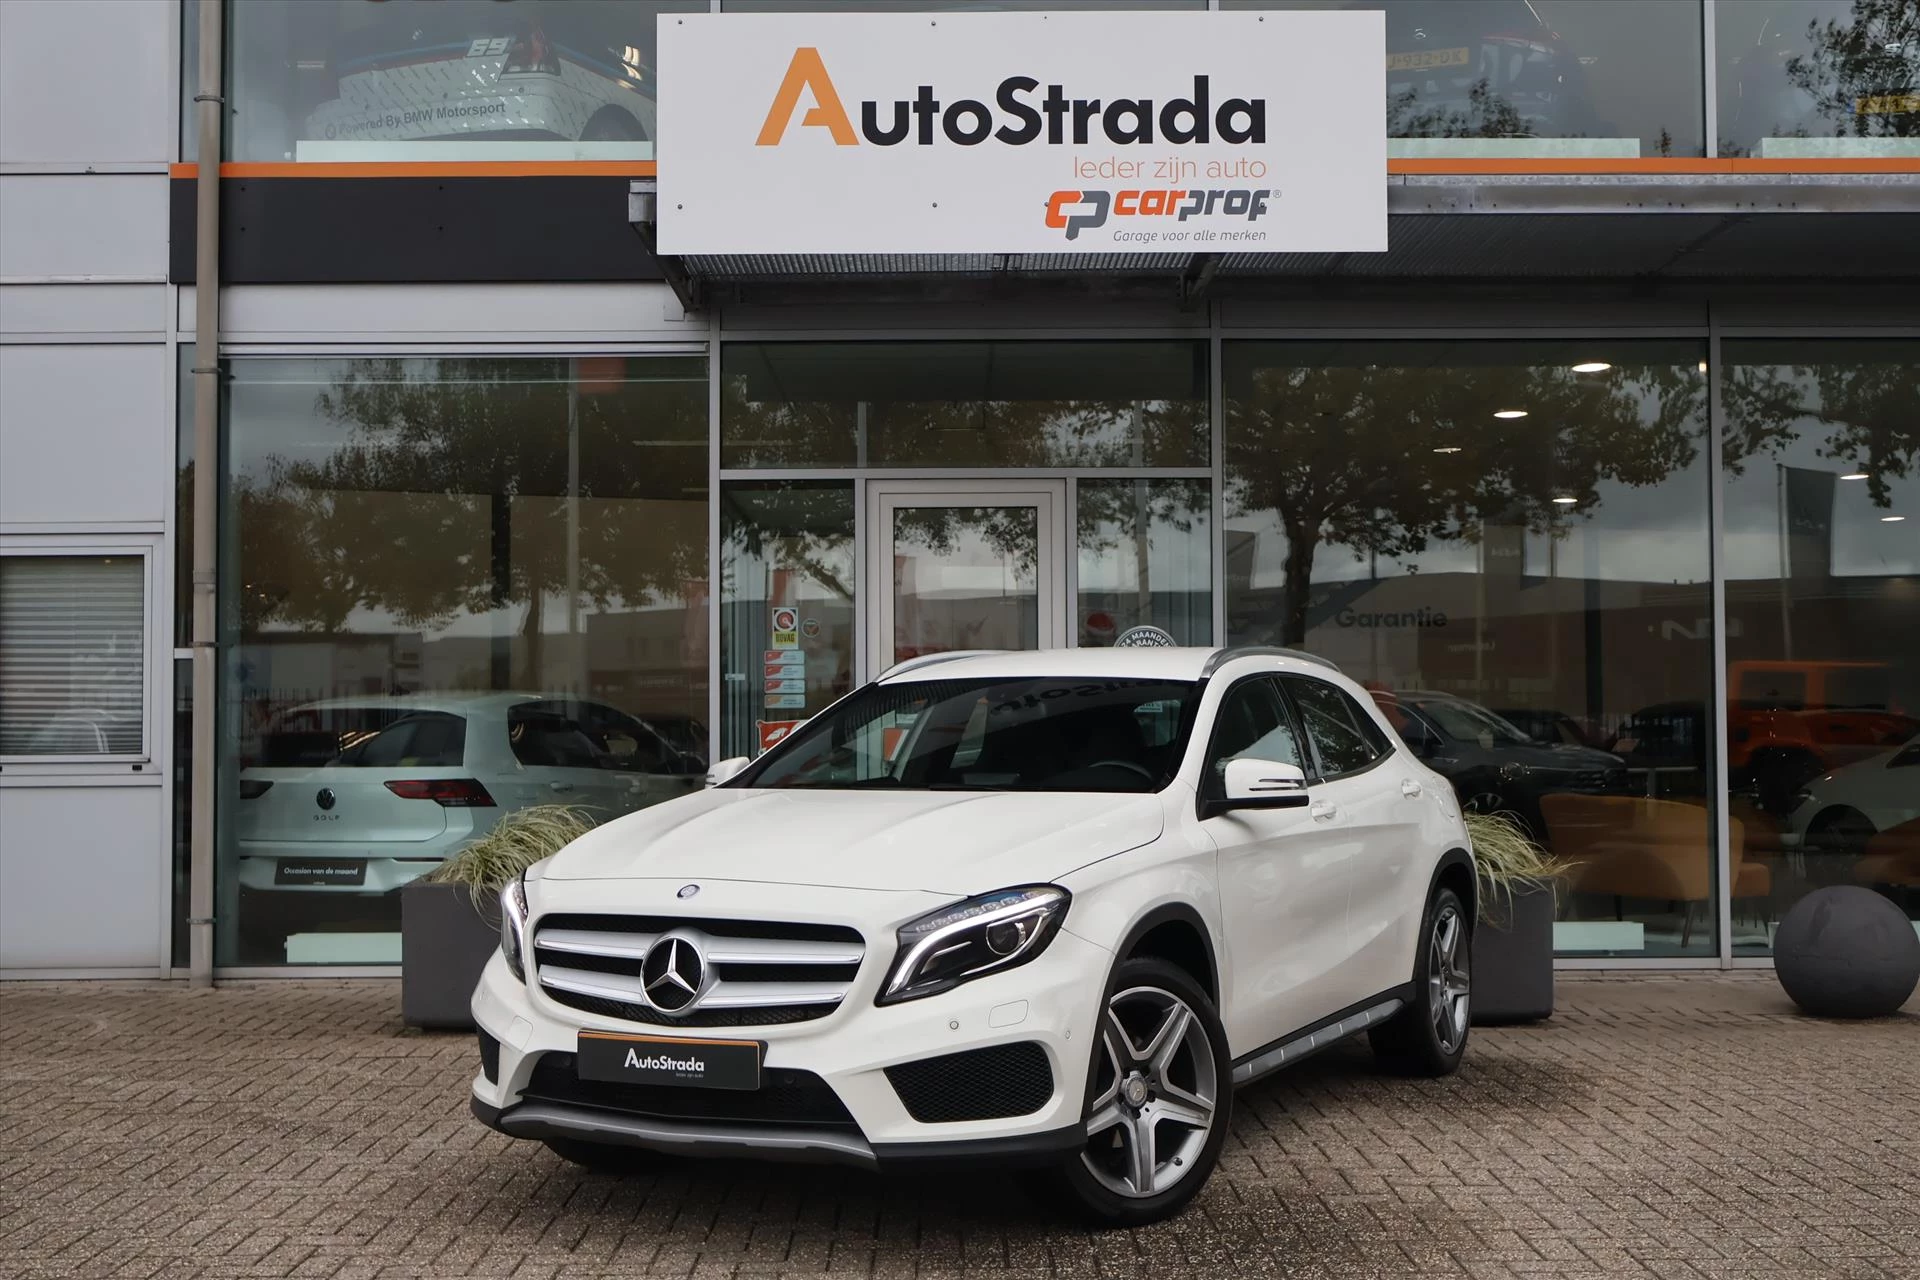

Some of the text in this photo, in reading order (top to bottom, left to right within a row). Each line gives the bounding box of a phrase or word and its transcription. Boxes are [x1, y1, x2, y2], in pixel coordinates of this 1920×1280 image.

[755, 47, 1266, 146] AutoStrada
[386, 115, 401, 129] By
[404, 108, 433, 124] BMW
[437, 103, 505, 119] Motorsport
[1074, 156, 1267, 184] Ieder zijn auto
[1113, 230, 1266, 244] Garage voor alle merken
[1335, 606, 1448, 627] Garantie
[284, 866, 311, 875] Occasion
[326, 867, 333, 875] de
[335, 867, 358, 876] maand
[624, 1047, 704, 1072] AutoStrada
